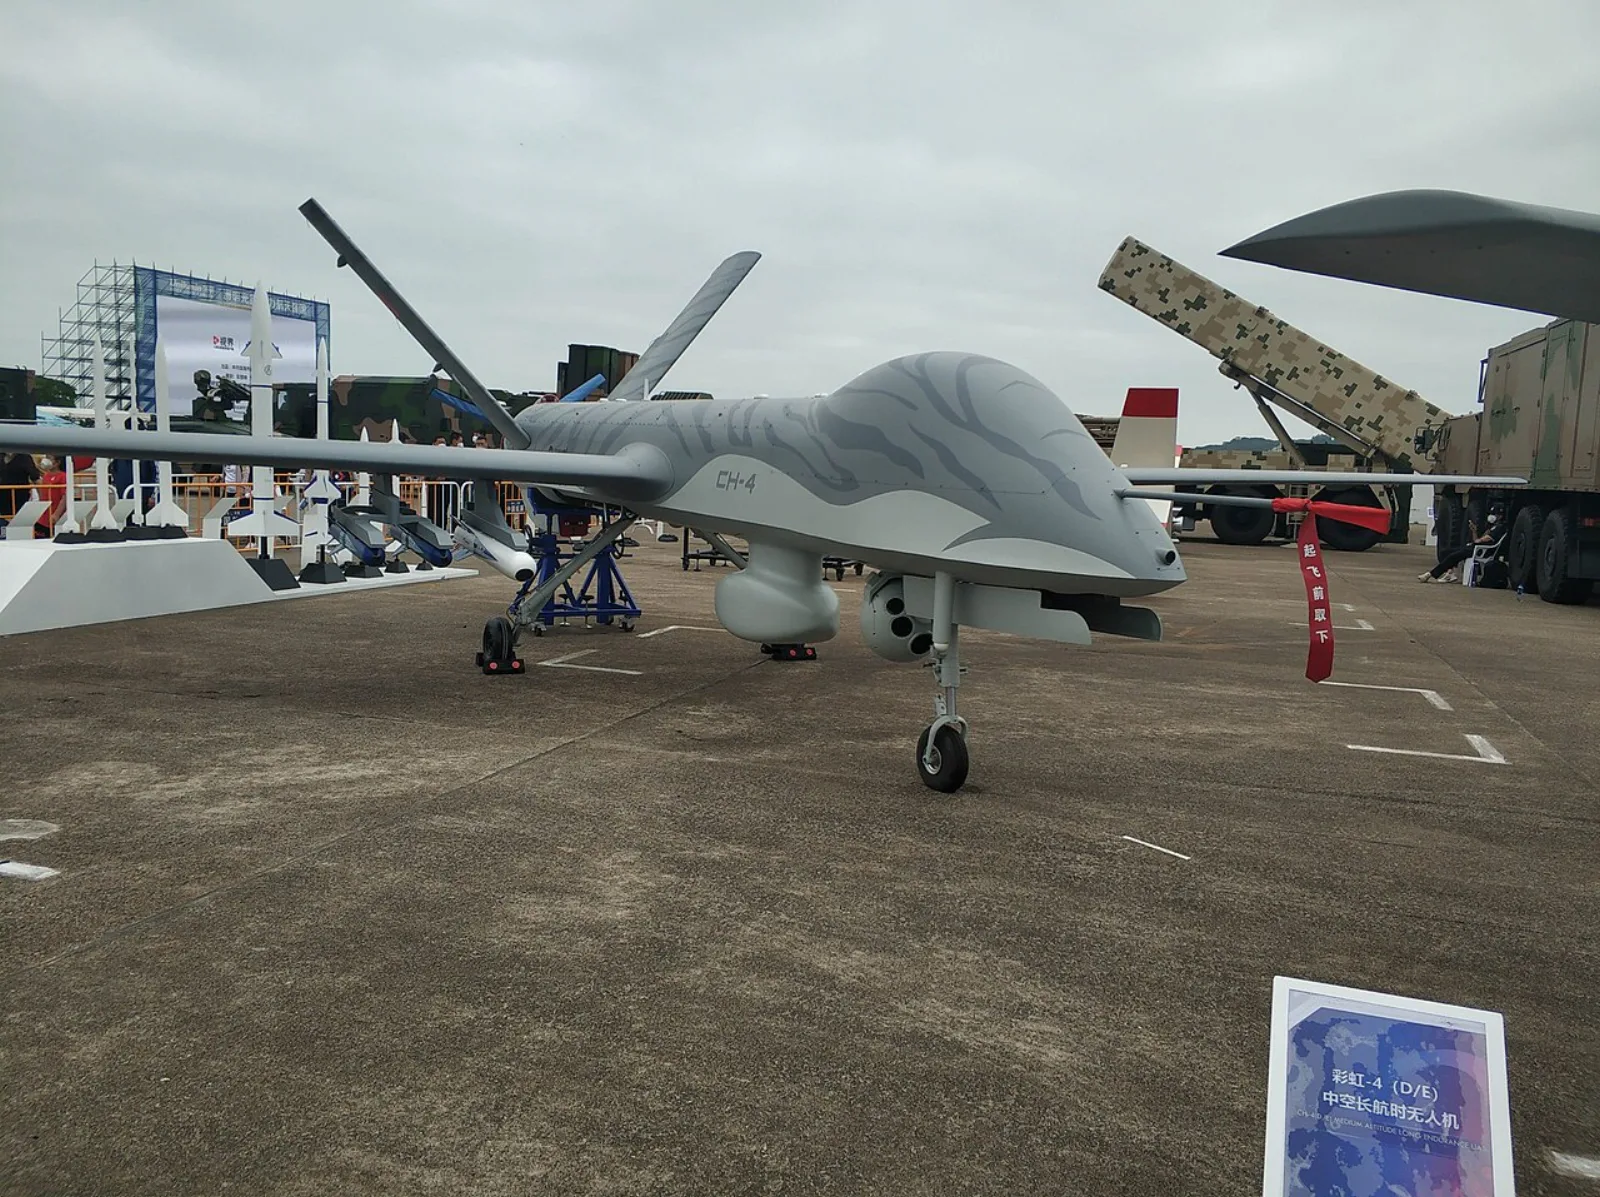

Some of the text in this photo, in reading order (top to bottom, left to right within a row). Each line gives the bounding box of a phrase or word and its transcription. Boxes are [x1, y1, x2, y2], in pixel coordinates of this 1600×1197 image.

[716, 470, 756, 494] CH-4
[1303, 543, 1329, 644] 起飞前取下
[1323, 1090, 1460, 1130] 中空长航时无人机
[1398, 1128, 1421, 1139] LONG
